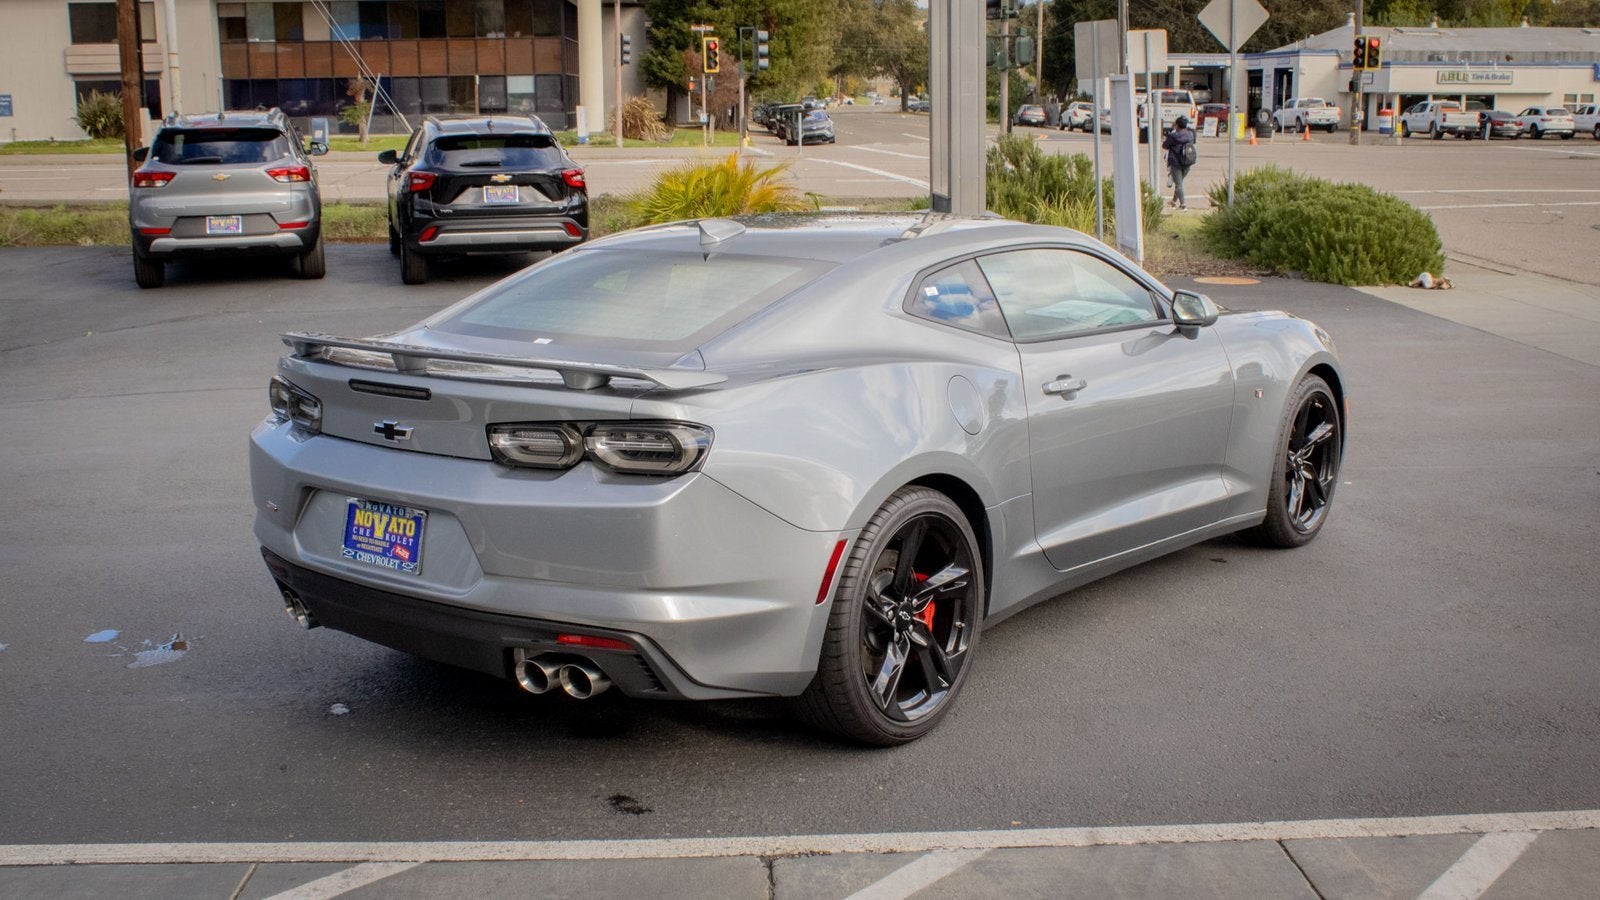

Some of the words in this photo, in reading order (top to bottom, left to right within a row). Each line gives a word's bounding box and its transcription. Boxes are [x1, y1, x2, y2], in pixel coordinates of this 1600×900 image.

[1441, 72, 1469, 82] ABLE
[366, 502, 405, 516] NOVATO
[354, 509, 416, 539] NOVATO
[356, 550, 400, 569] CHEVROLET
